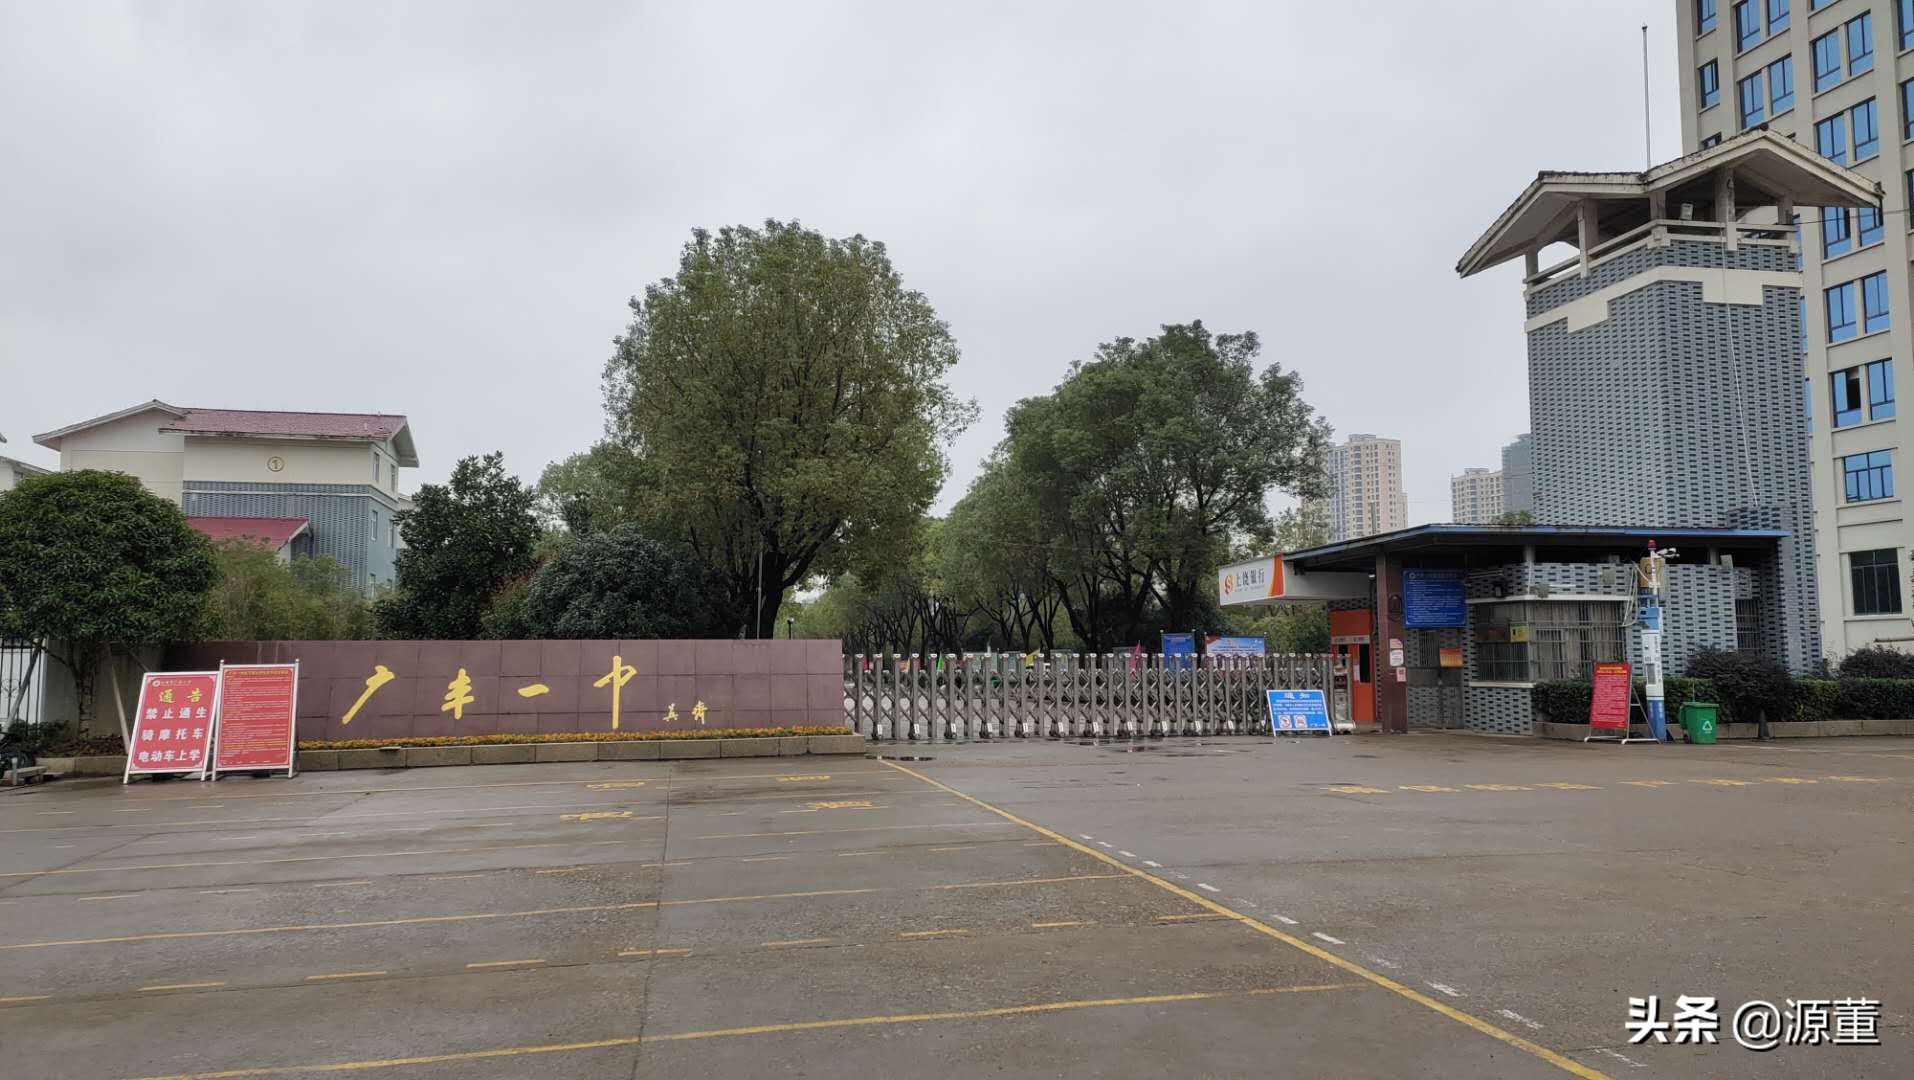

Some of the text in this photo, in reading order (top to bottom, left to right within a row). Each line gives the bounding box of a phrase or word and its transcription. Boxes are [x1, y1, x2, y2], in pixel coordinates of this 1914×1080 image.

[1235, 567, 1265, 588] 上饶银行
[159, 687, 203, 704] 通告
[341, 655, 638, 729] 广丰一中
[141, 727, 205, 741] 骑摩托车
[138, 748, 201, 762] 电动车上学
